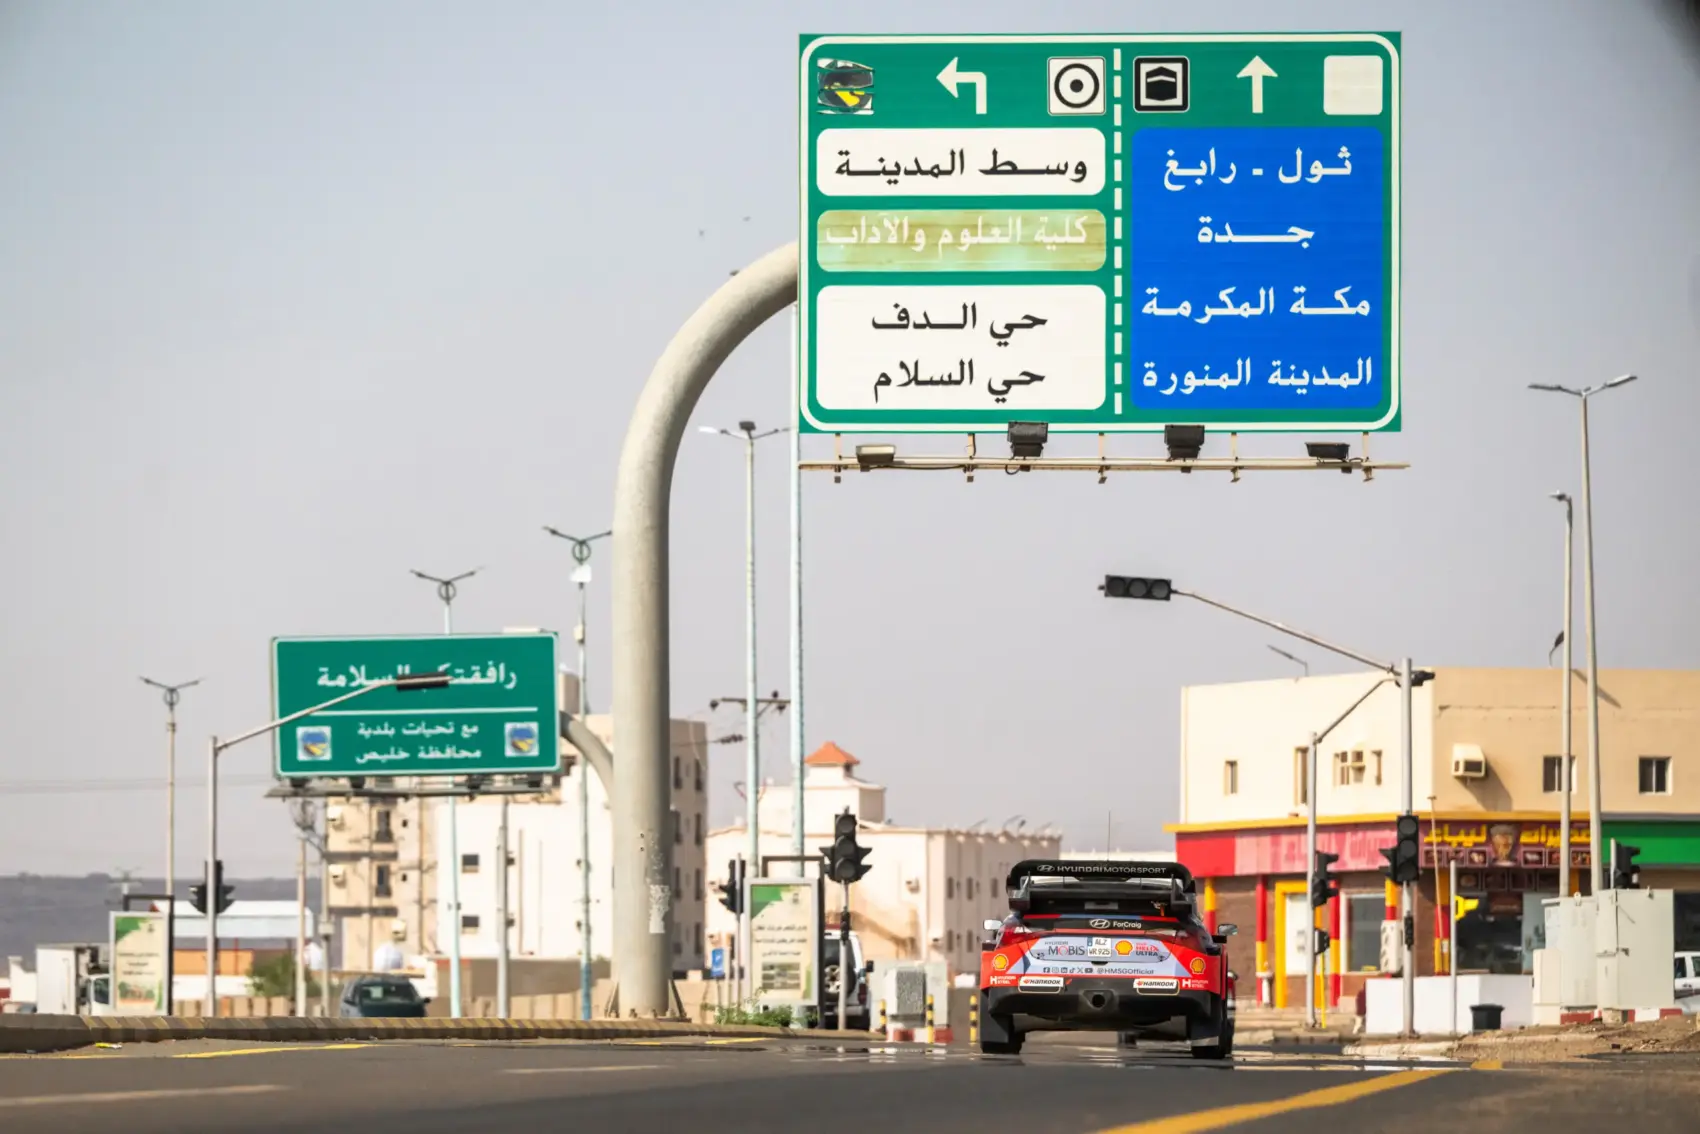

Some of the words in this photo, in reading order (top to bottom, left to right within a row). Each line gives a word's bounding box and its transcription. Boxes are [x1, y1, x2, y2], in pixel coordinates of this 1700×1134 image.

[834, 148, 966, 186] المدينة
[979, 148, 1088, 183] وسط
[1163, 147, 1237, 191] رابغ
[1278, 146, 1353, 184] ثول
[937, 214, 1022, 261] العلوم
[1033, 214, 1089, 251] كلية
[1197, 215, 1316, 249] جدة
[871, 301, 977, 331] الدف
[1141, 286, 1275, 325] المكرمة
[1289, 285, 1371, 317] مكة
[989, 313, 1048, 347] حي
[873, 358, 975, 403] السلام
[987, 369, 1046, 404] حي
[1142, 357, 1252, 395] المنورة
[1267, 356, 1373, 396] المدينة
[357, 721, 397, 740] بلدية
[401, 720, 455, 739] تحيات
[460, 724, 480, 739] مع
[355, 745, 411, 764] خليص
[417, 744, 482, 760] محافظة
[1103, 866, 1167, 875] MOTORSPORT
[1112, 920, 1142, 930] ForCraig
[1048, 945, 1086, 956] MOBIS
